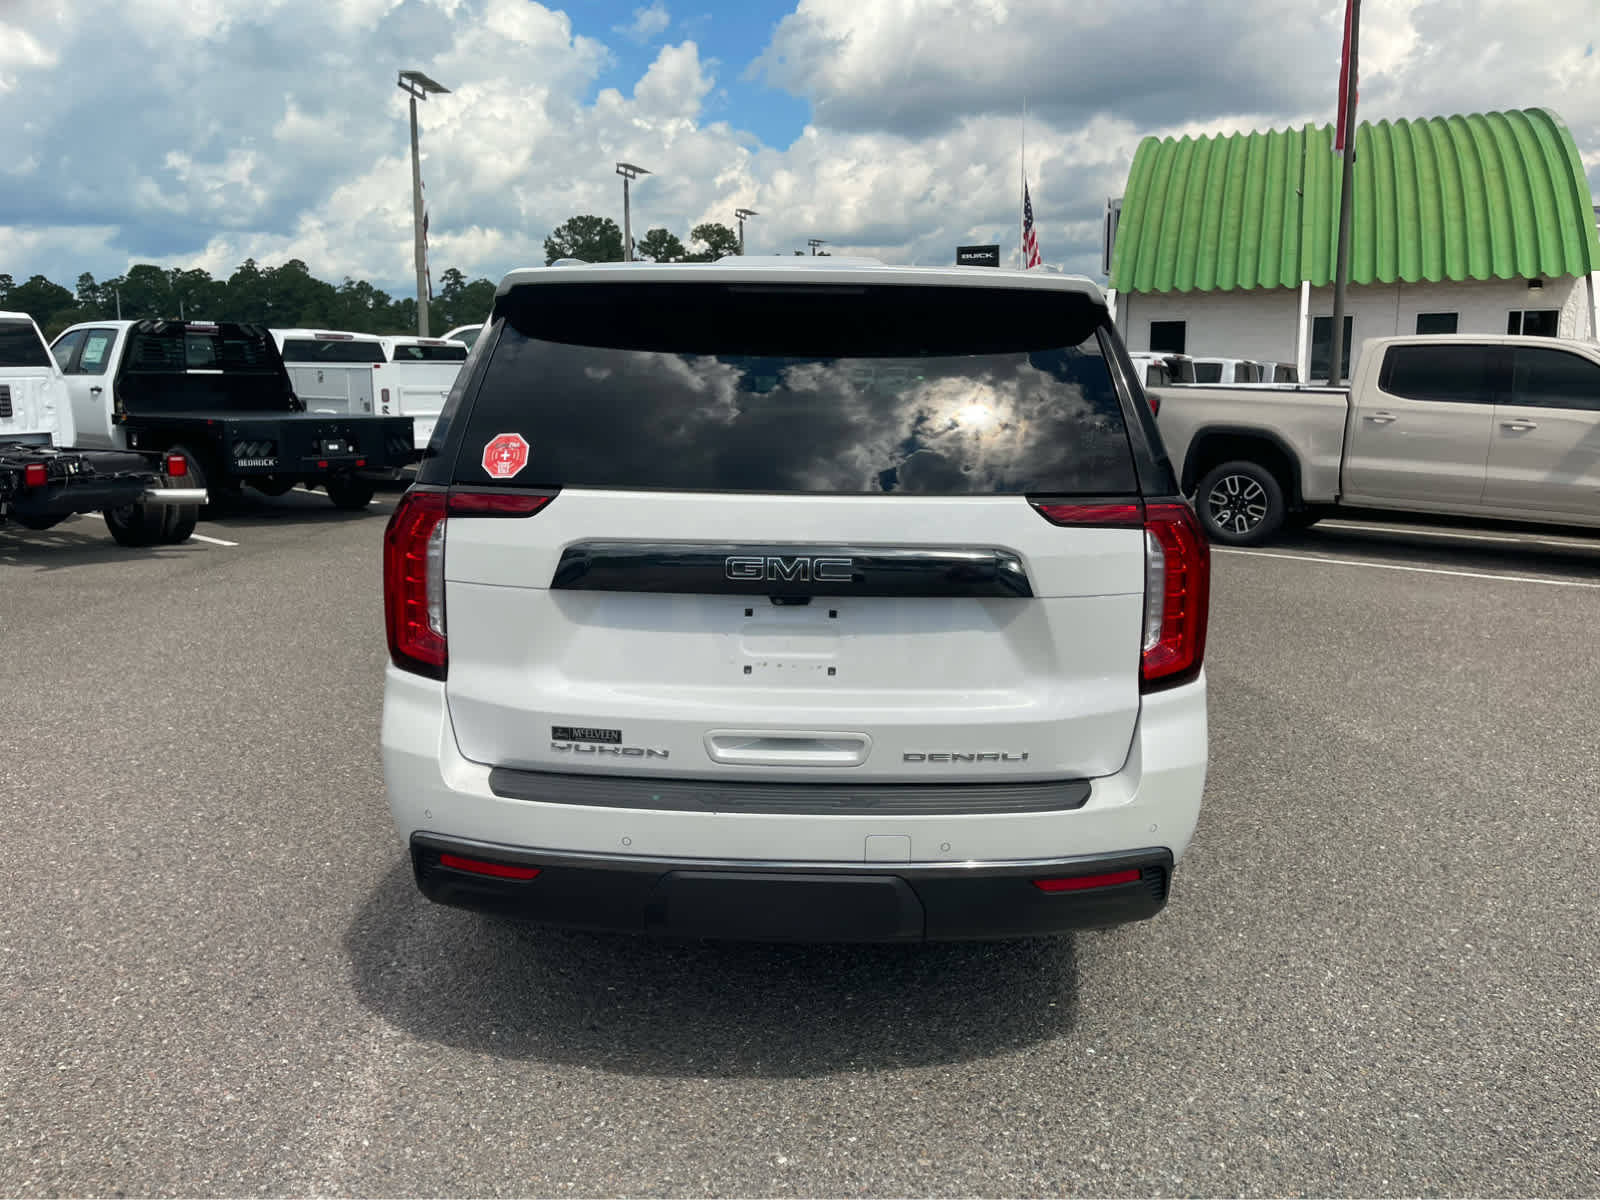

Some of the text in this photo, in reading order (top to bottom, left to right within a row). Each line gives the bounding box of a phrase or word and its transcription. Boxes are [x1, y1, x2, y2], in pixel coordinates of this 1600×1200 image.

[238, 459, 274, 467] BEDROCK
[725, 556, 852, 581] GMC
[551, 742, 669, 758] YUKON
[903, 753, 1028, 761] DENALI
